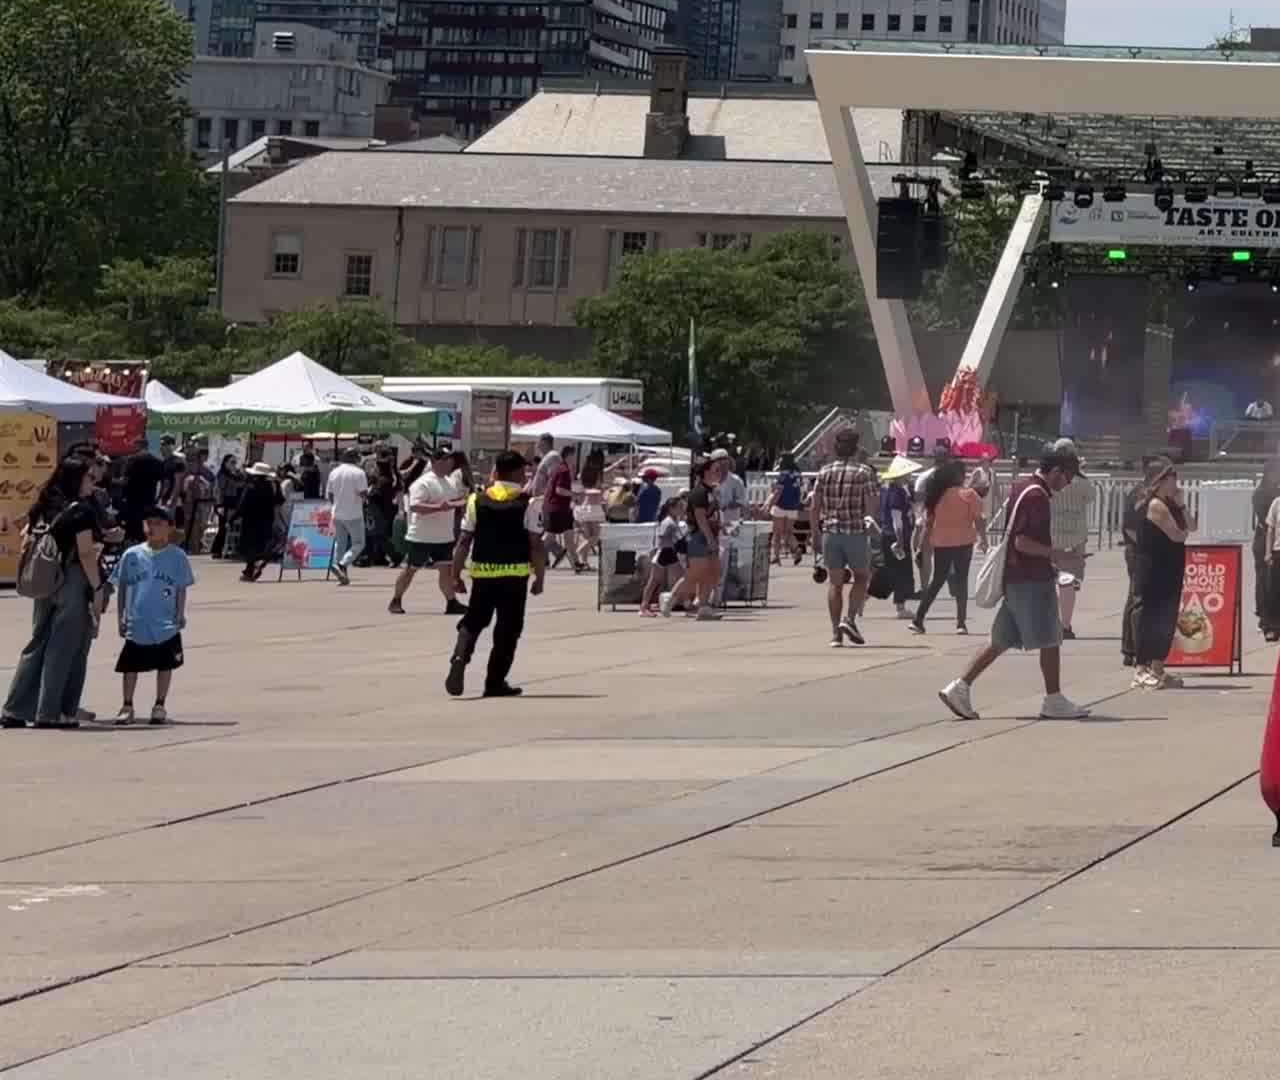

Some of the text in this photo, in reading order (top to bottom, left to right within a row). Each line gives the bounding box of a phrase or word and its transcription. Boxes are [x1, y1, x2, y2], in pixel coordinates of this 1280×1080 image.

[1164, 207, 1249, 226] TASTE
[513, 391, 560, 404] AUL
[161, 414, 191, 426] Your
[224, 412, 274, 428] Journey
[276, 414, 317, 429] Expert
[1184, 563, 1226, 576] ORLD
[1179, 593, 1225, 614] AO
